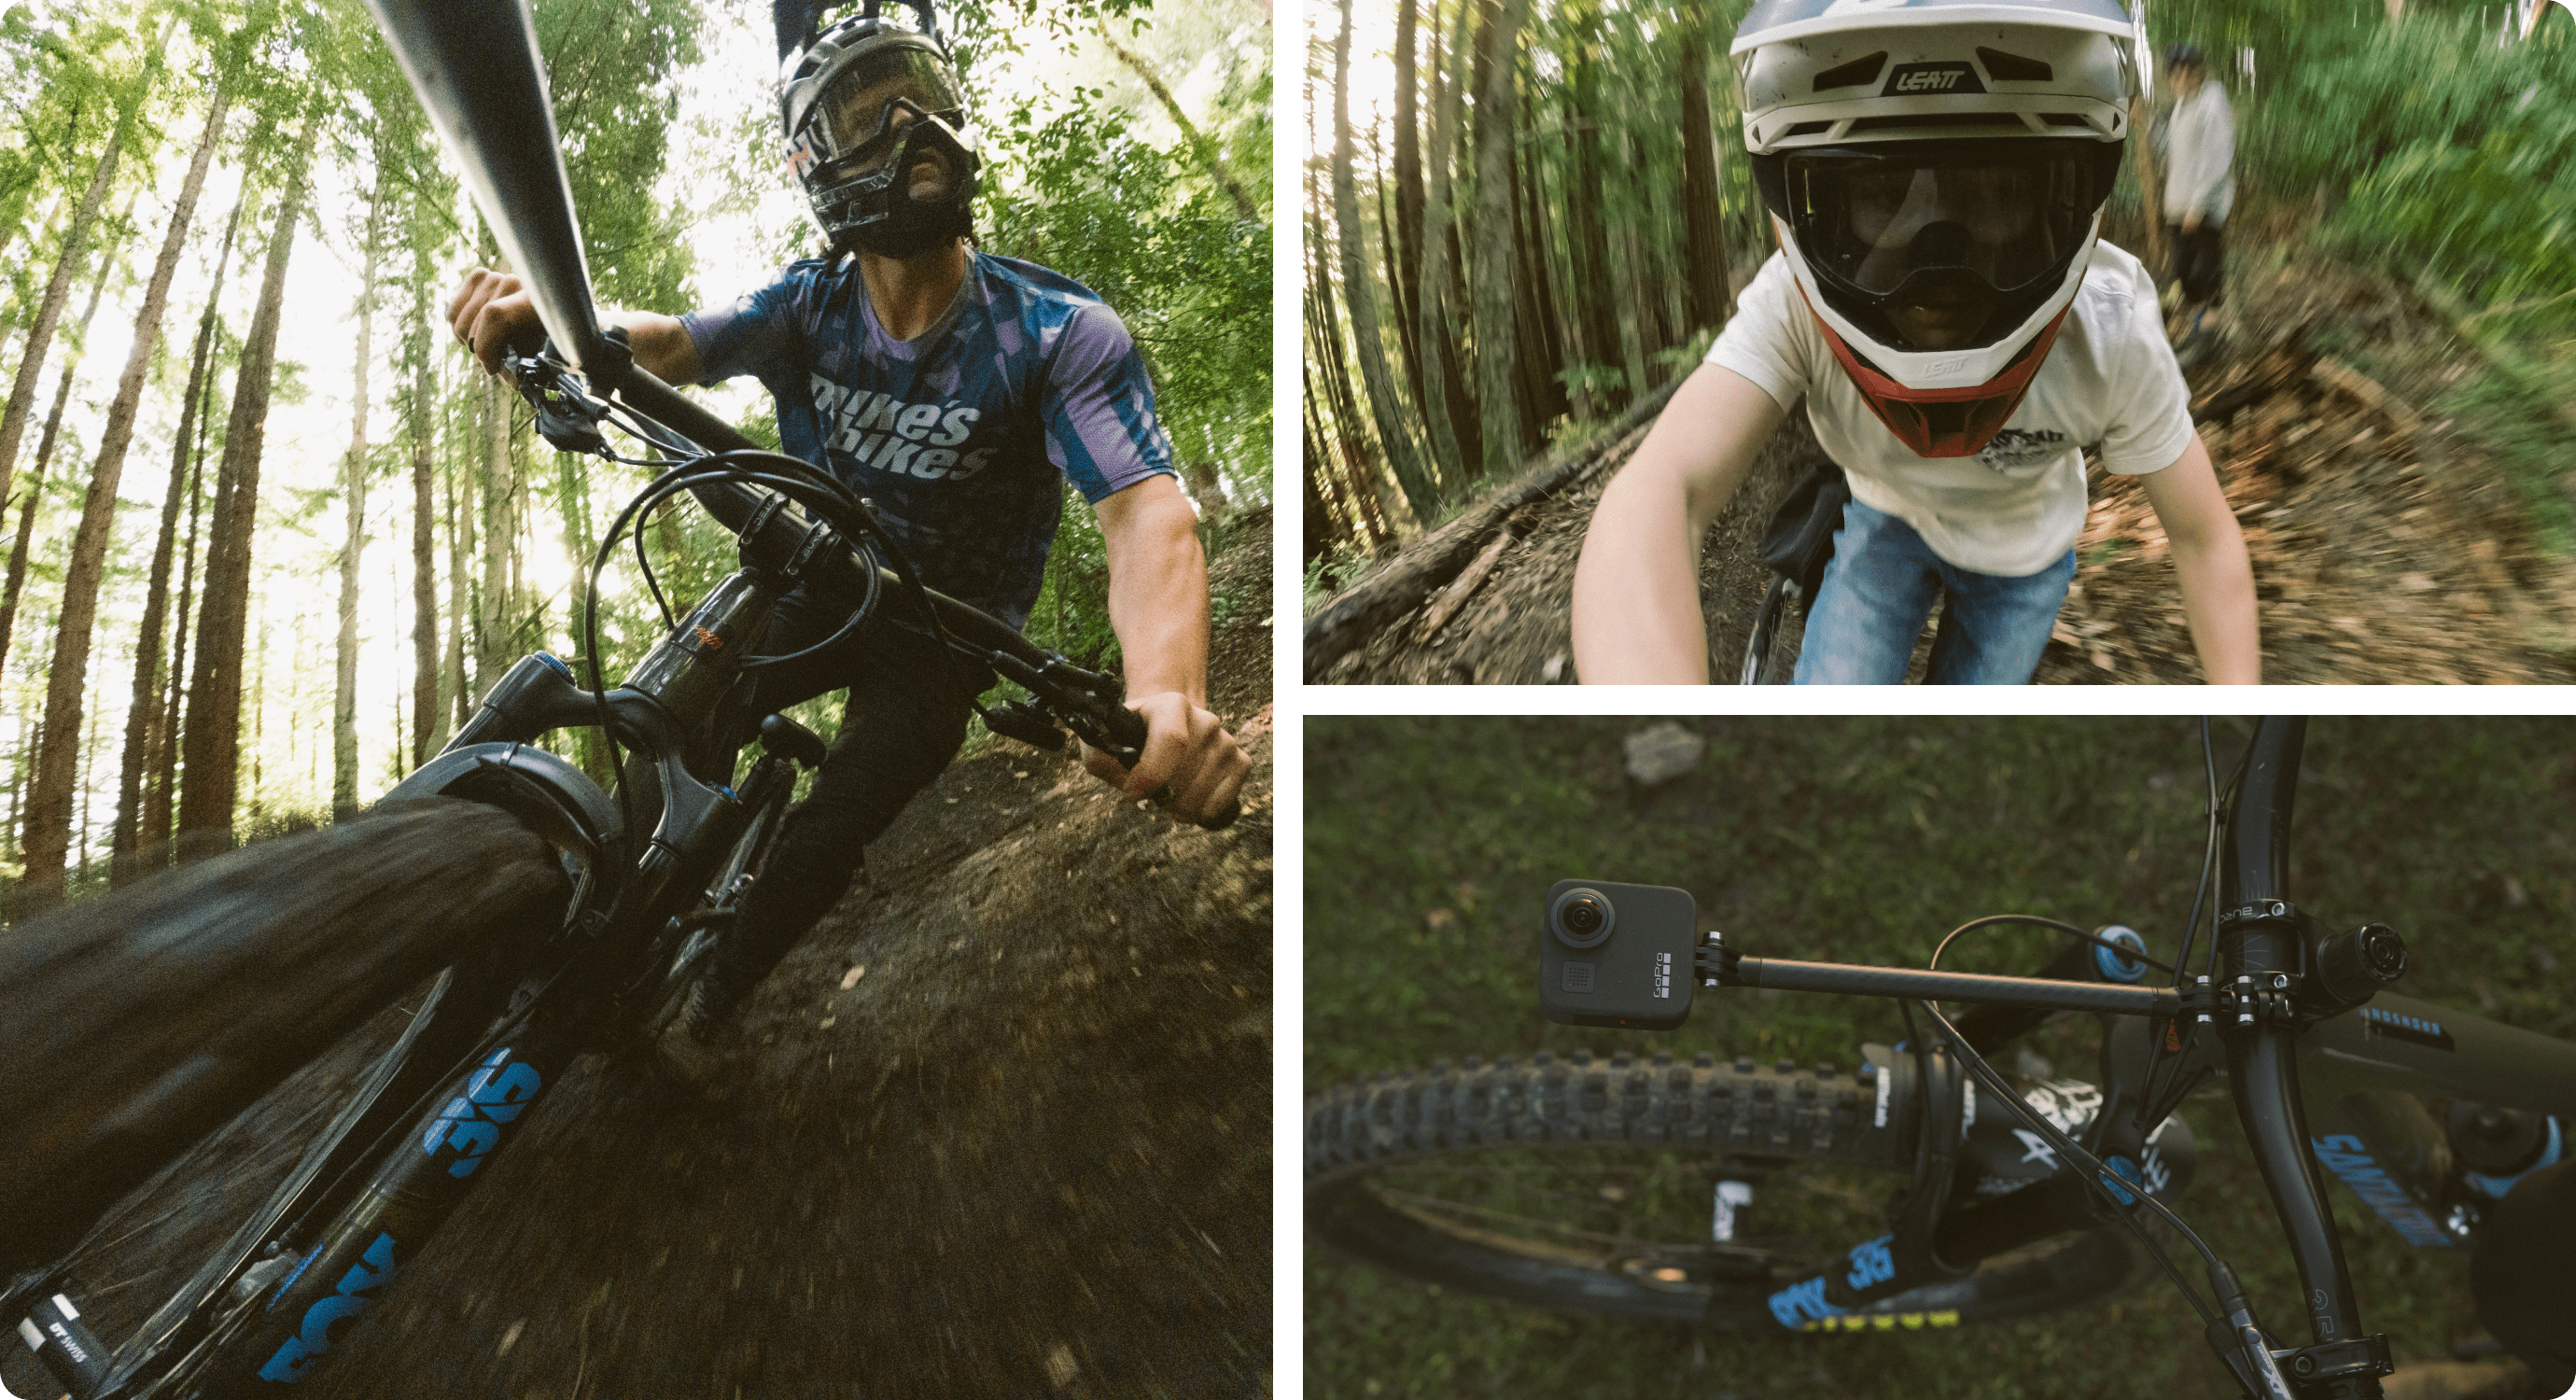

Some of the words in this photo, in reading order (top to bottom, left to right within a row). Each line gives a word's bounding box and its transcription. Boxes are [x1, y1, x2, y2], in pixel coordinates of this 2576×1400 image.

[1896, 70, 1965, 91] LEATT
[1652, 952, 1663, 999] GoPro
[423, 1047, 541, 1178] 36
[49, 1323, 69, 1338] DT
[62, 1336, 88, 1363] SWISS
[2261, 1368, 2292, 1400] XT
